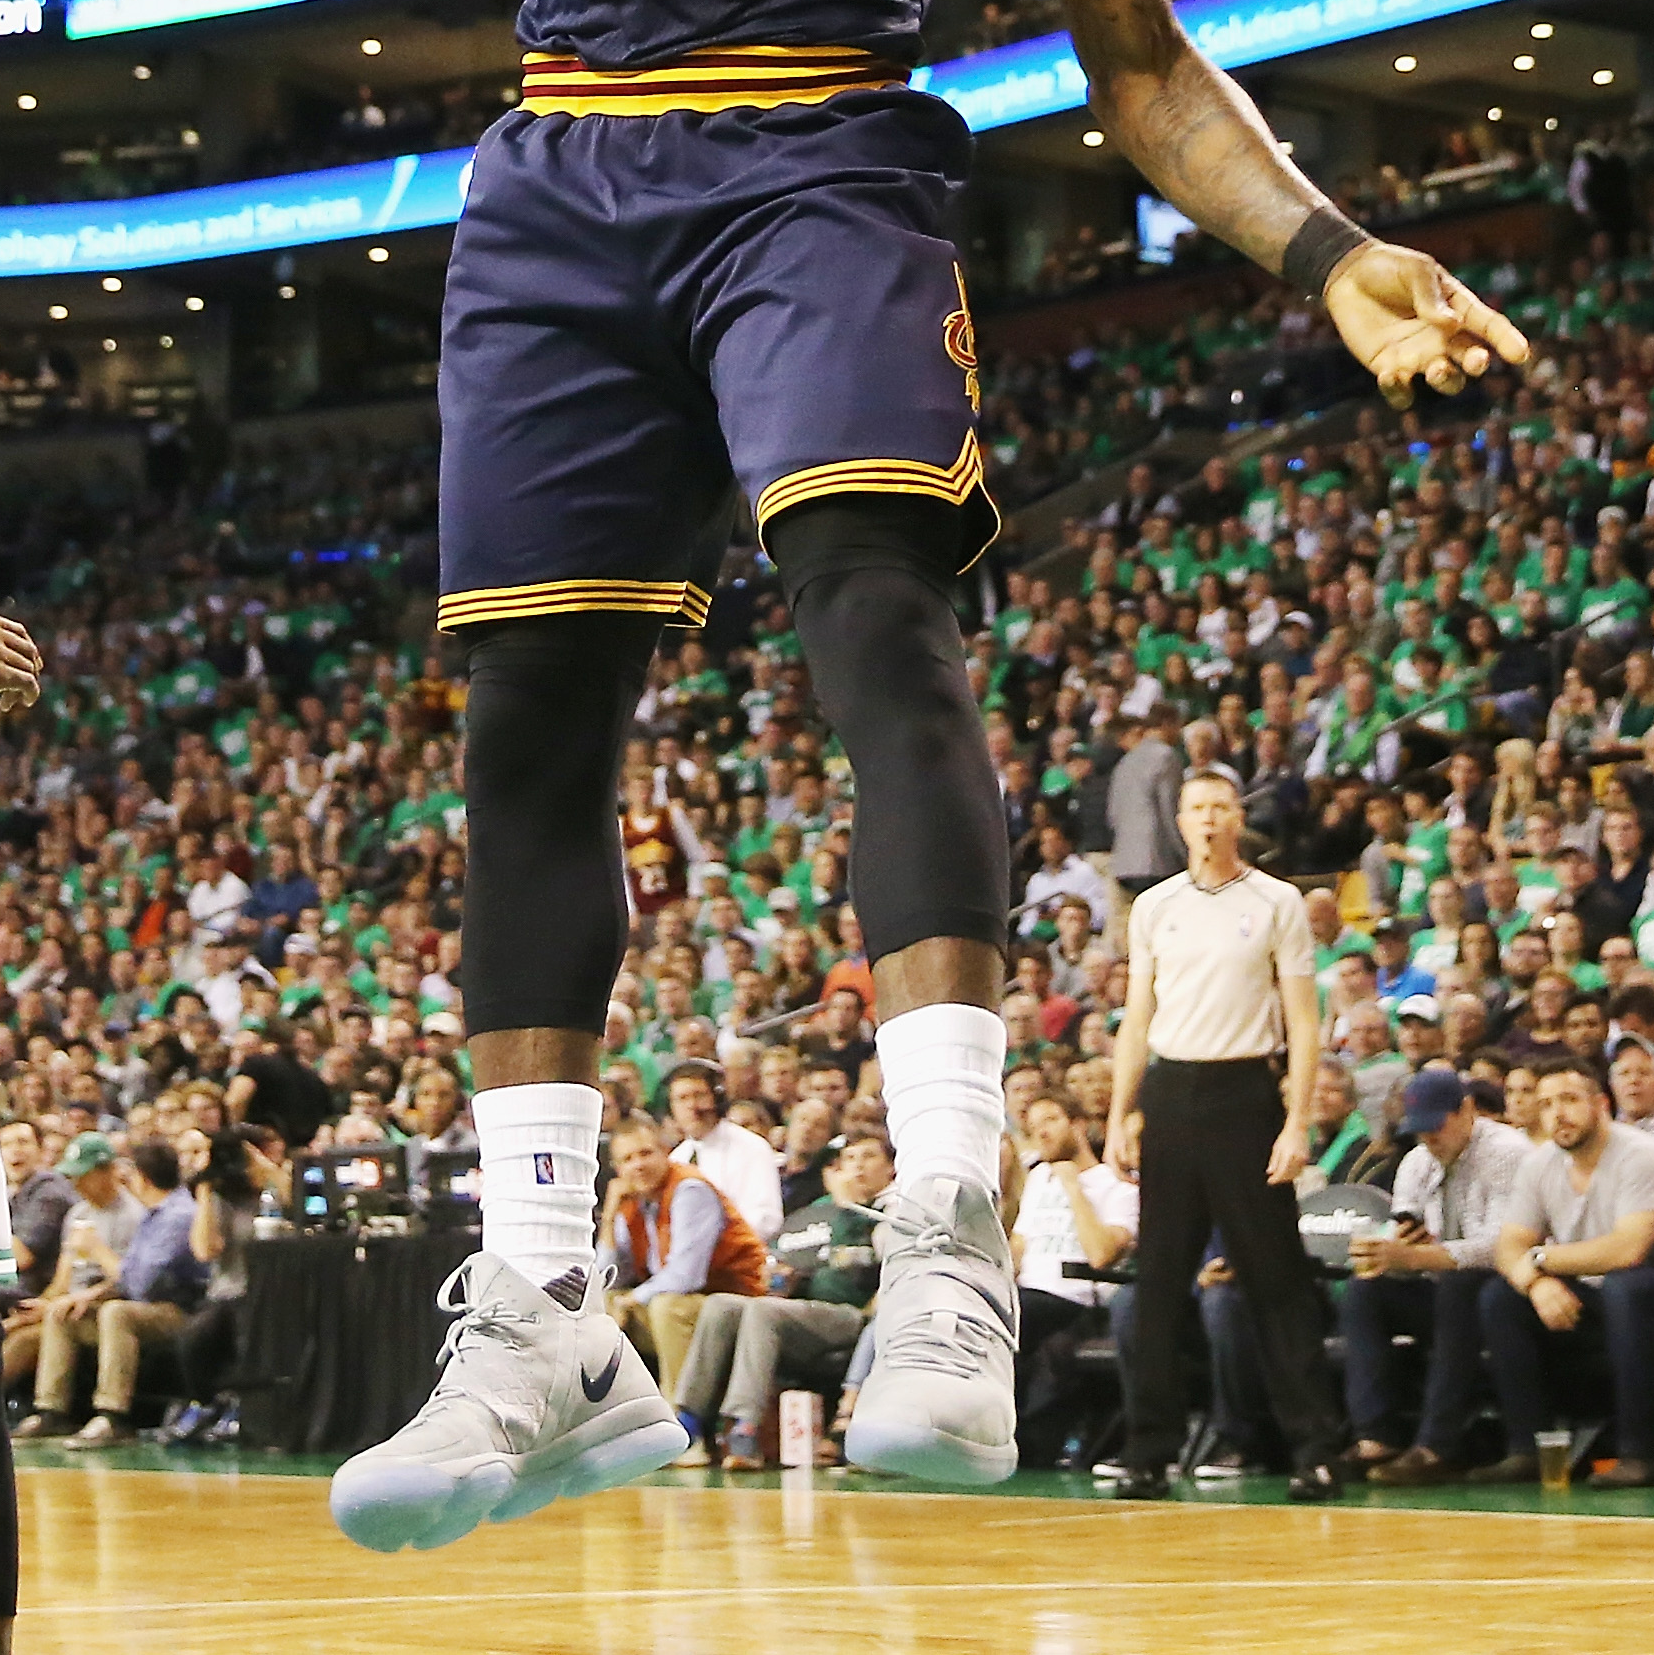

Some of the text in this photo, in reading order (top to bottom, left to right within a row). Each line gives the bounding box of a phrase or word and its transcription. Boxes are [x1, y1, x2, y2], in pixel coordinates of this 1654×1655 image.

[77, 218, 203, 258] Solutions
[203, 204, 255, 241] and
[255, 196, 363, 235] Services
